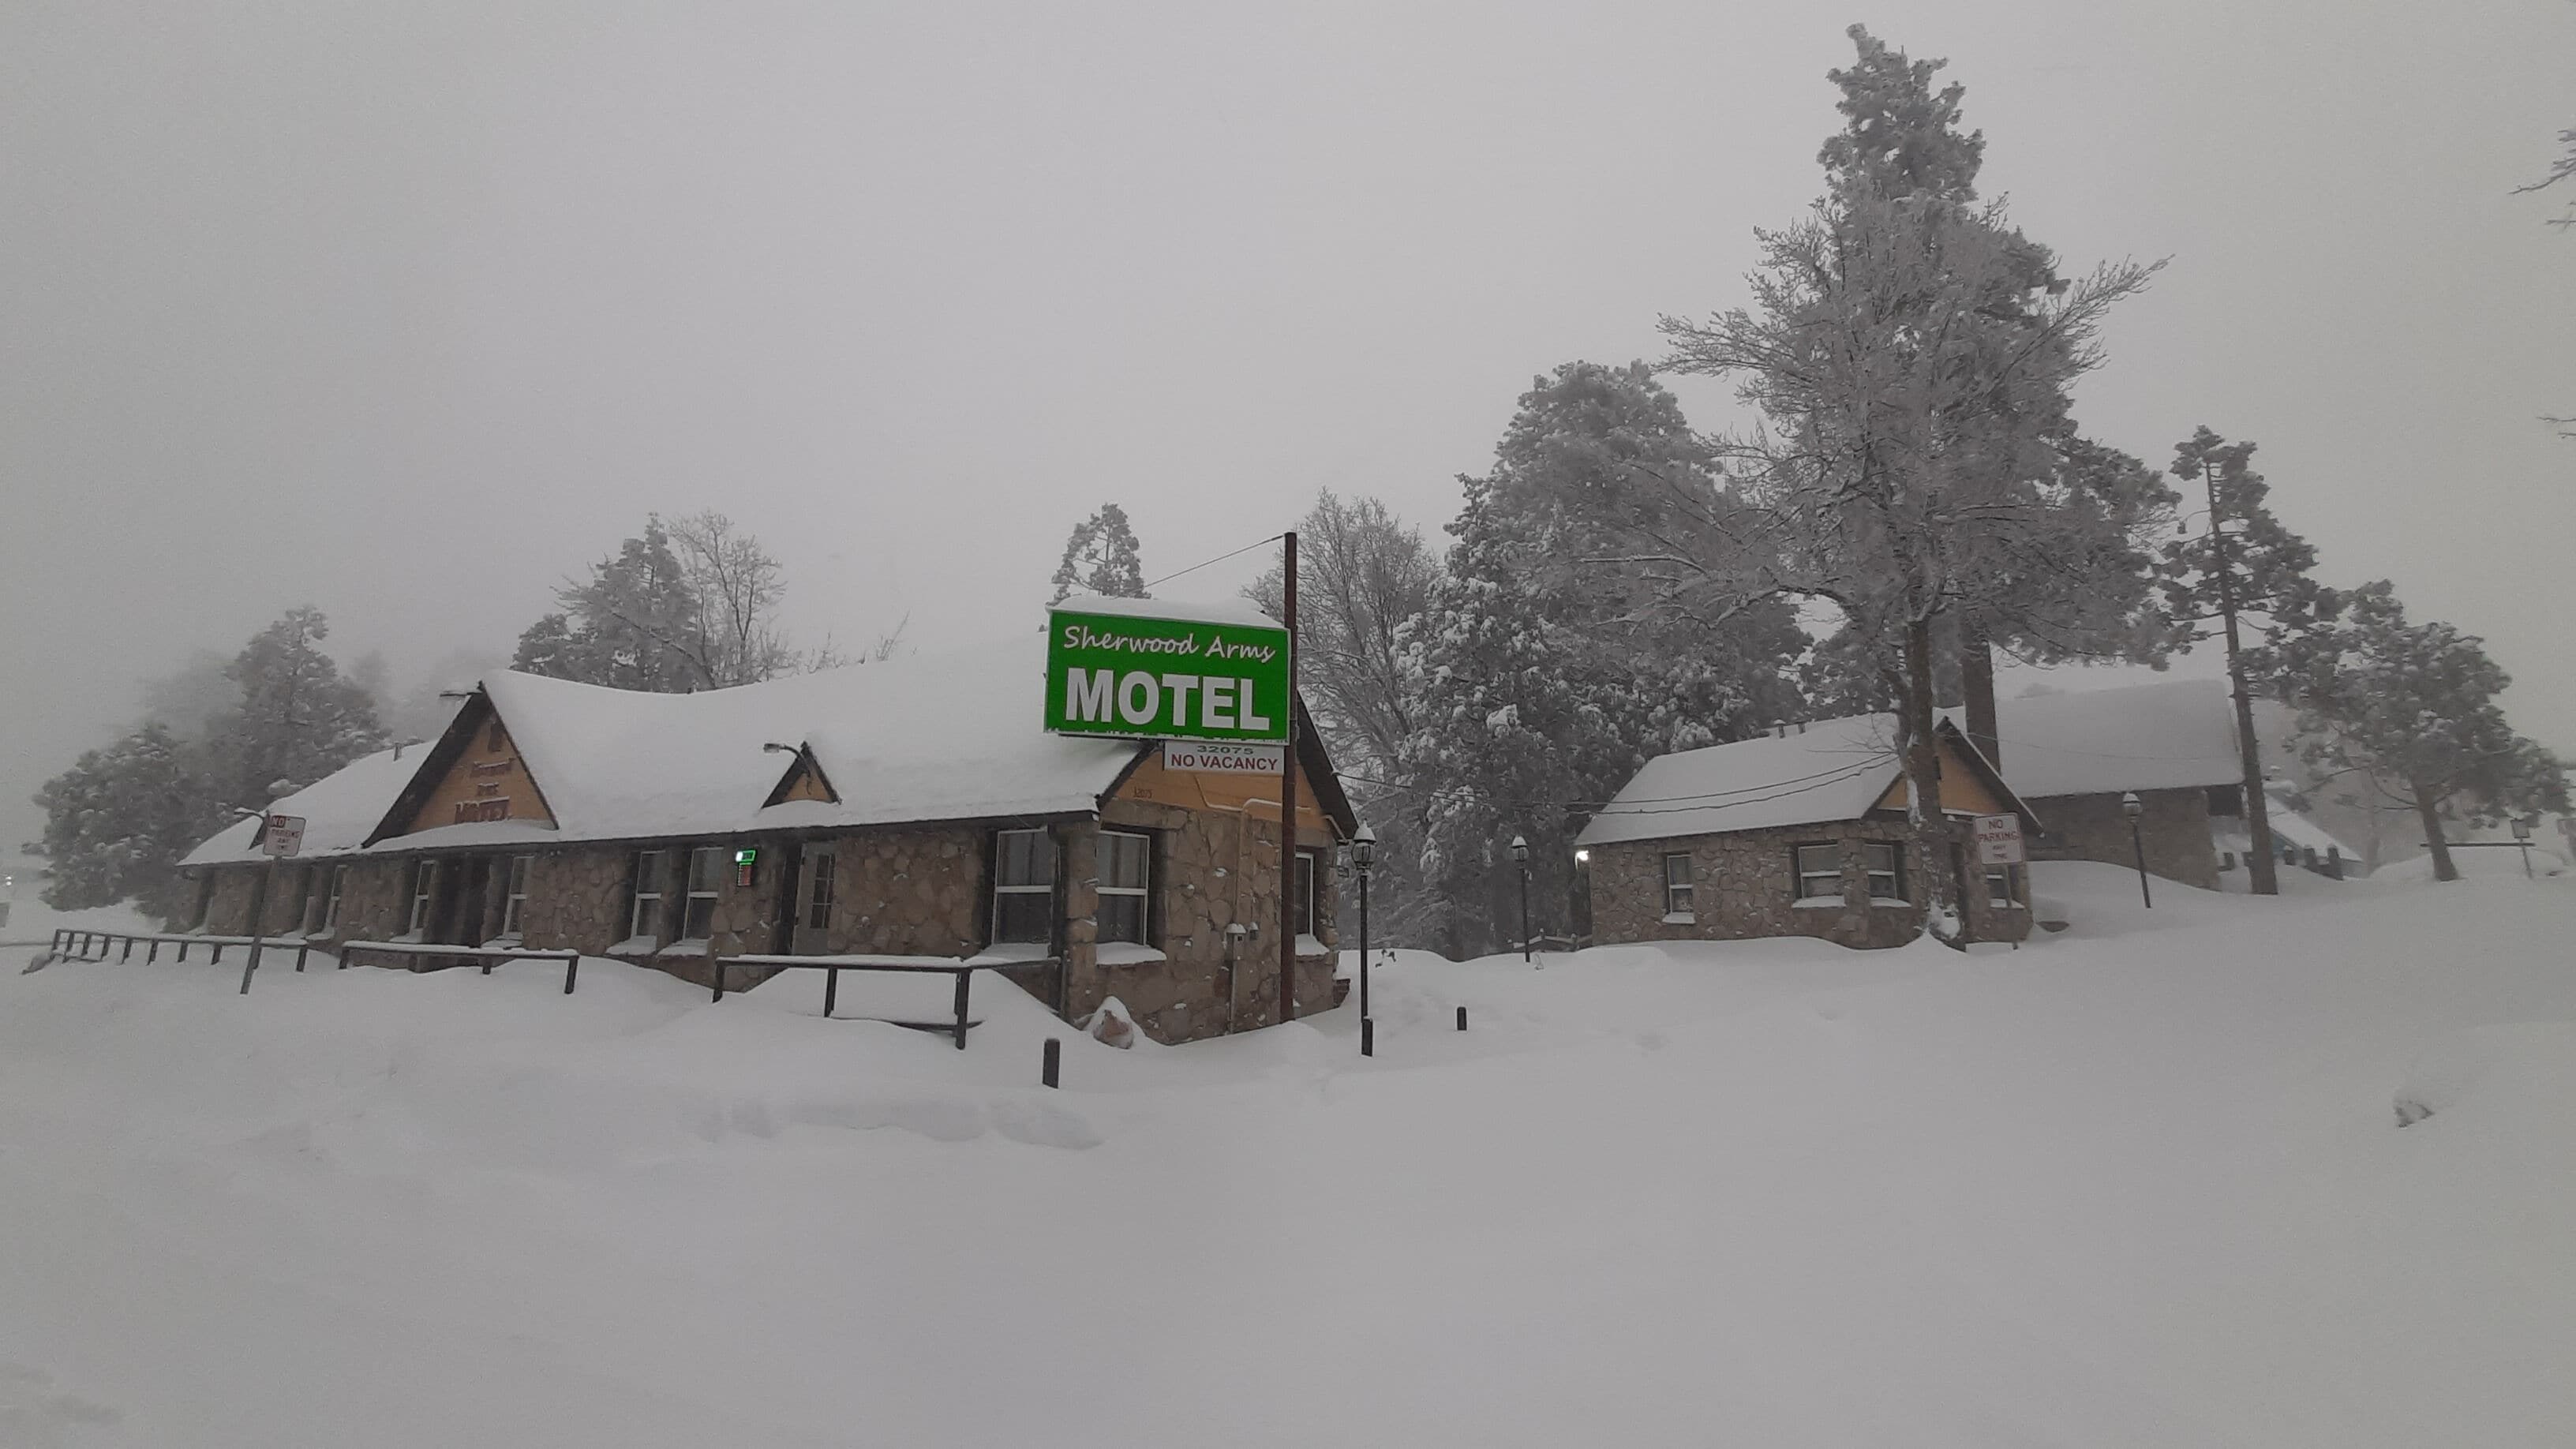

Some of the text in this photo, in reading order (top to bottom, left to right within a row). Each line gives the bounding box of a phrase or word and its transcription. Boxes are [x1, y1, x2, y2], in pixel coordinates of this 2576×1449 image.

[1064, 626, 1276, 664] Sherwood Arms
[1065, 667, 1270, 731] MOTEL
[1196, 744, 1255, 755] 32075
[1171, 754, 1279, 771] NO VACANCY
[271, 816, 285, 827] NO
[1988, 819, 2003, 829] NO
[1977, 830, 2020, 842] PARKING
